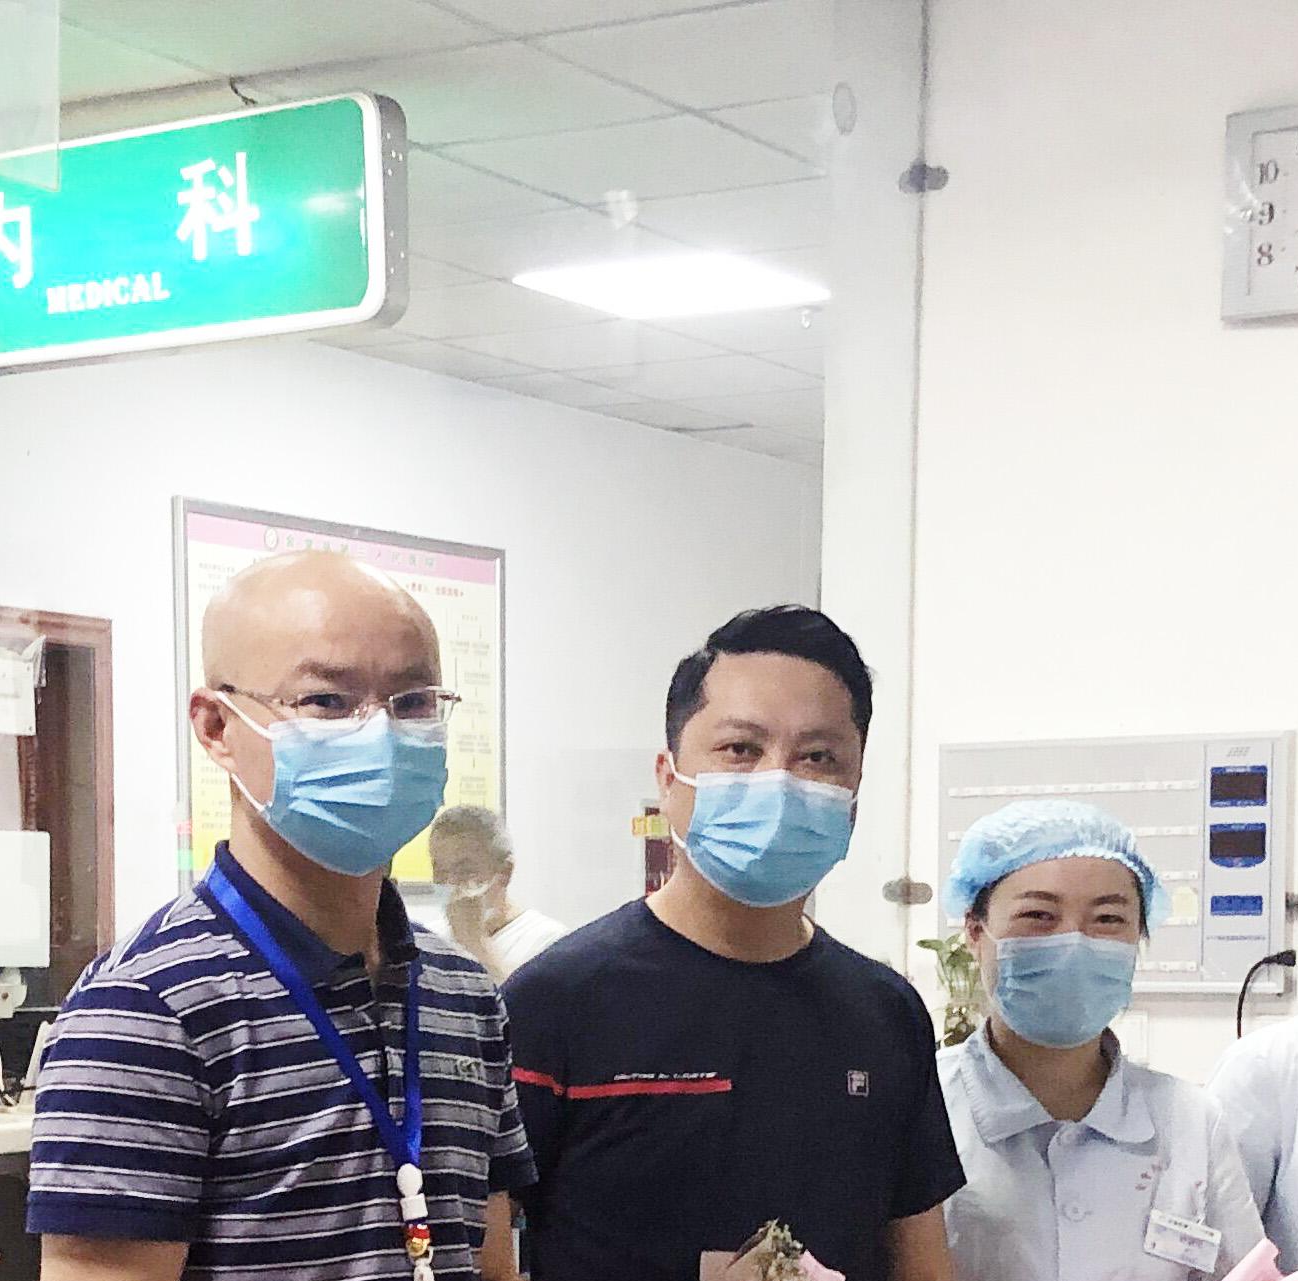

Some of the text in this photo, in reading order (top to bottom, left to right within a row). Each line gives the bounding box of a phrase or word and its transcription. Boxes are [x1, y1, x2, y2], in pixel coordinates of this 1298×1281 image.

[1257, 160, 1280, 185] 10
[1258, 202, 1275, 226] 9
[1257, 243, 1274, 266] 8
[46, 272, 170, 314] MEDICAL
